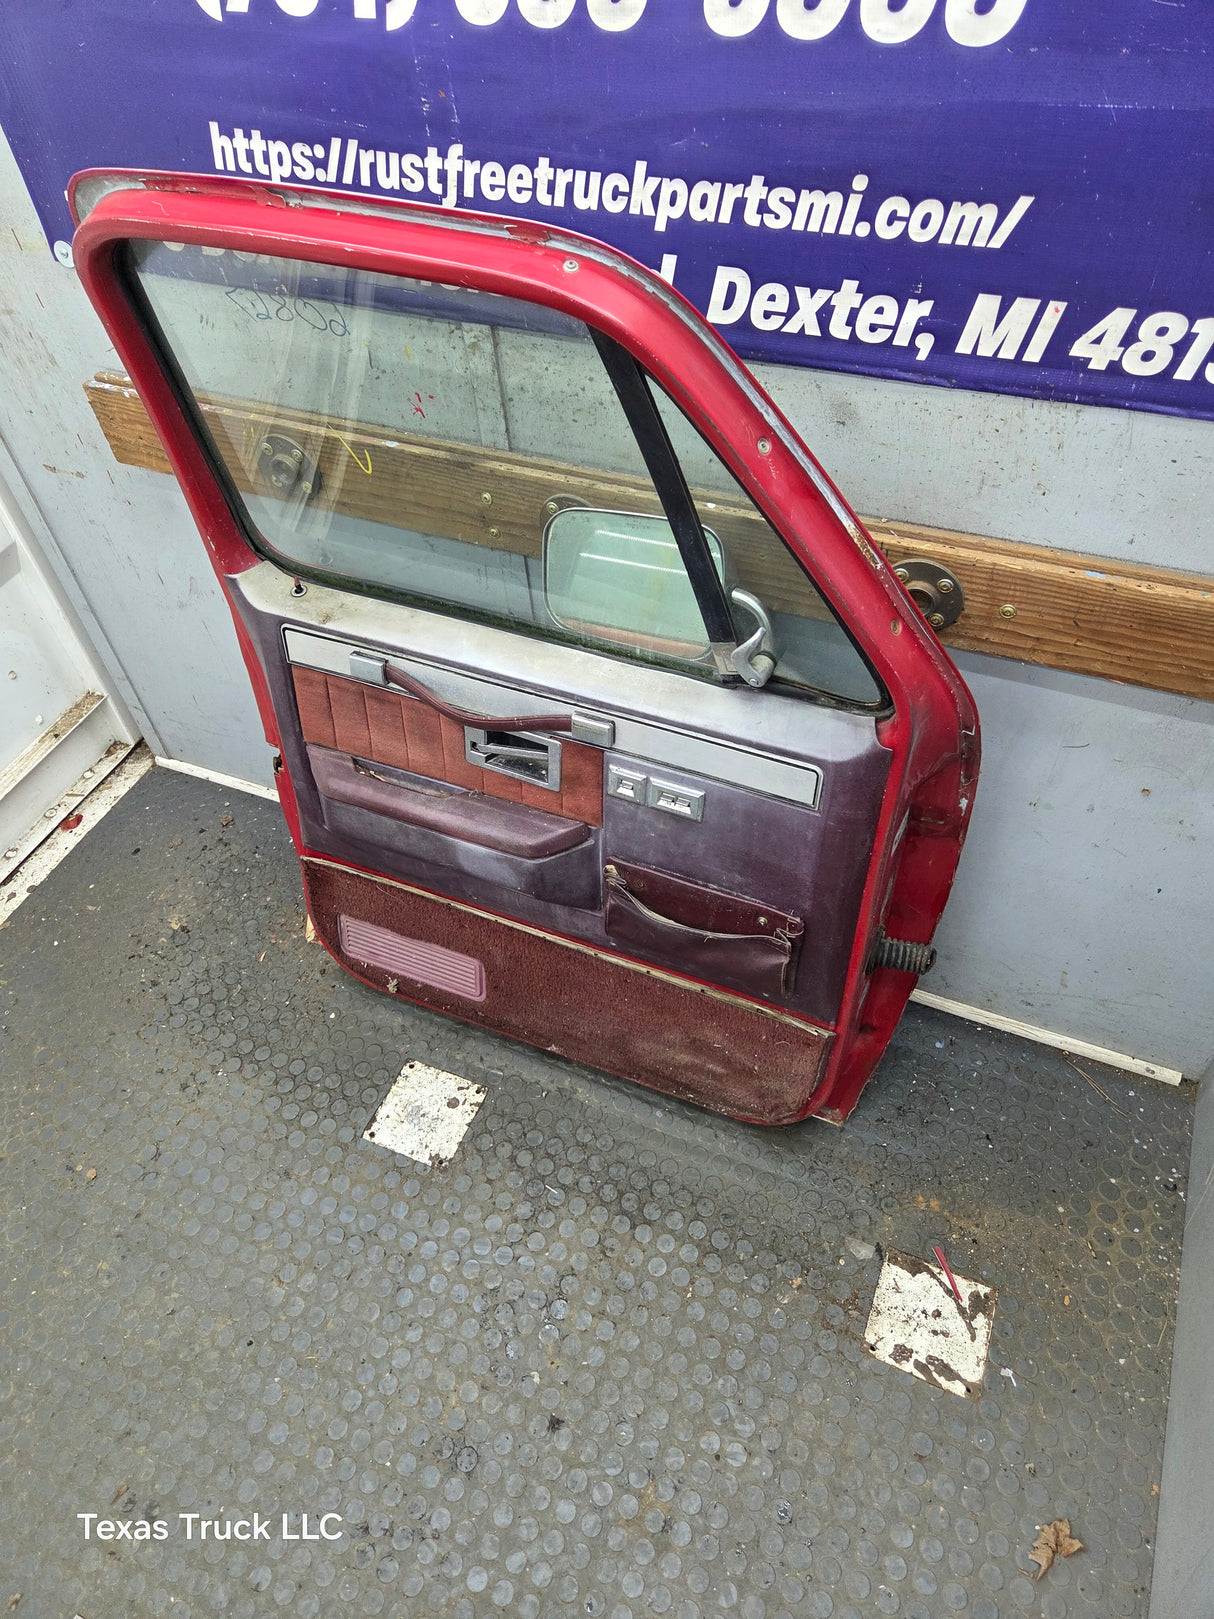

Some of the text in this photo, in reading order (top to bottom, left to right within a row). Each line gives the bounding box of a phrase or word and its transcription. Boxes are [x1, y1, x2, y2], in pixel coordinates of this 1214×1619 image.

[209, 121, 1035, 249] https://rustfreetruckpartsmi.com/
[706, 265, 935, 361] Dexter,
[955, 293, 1068, 363] MI
